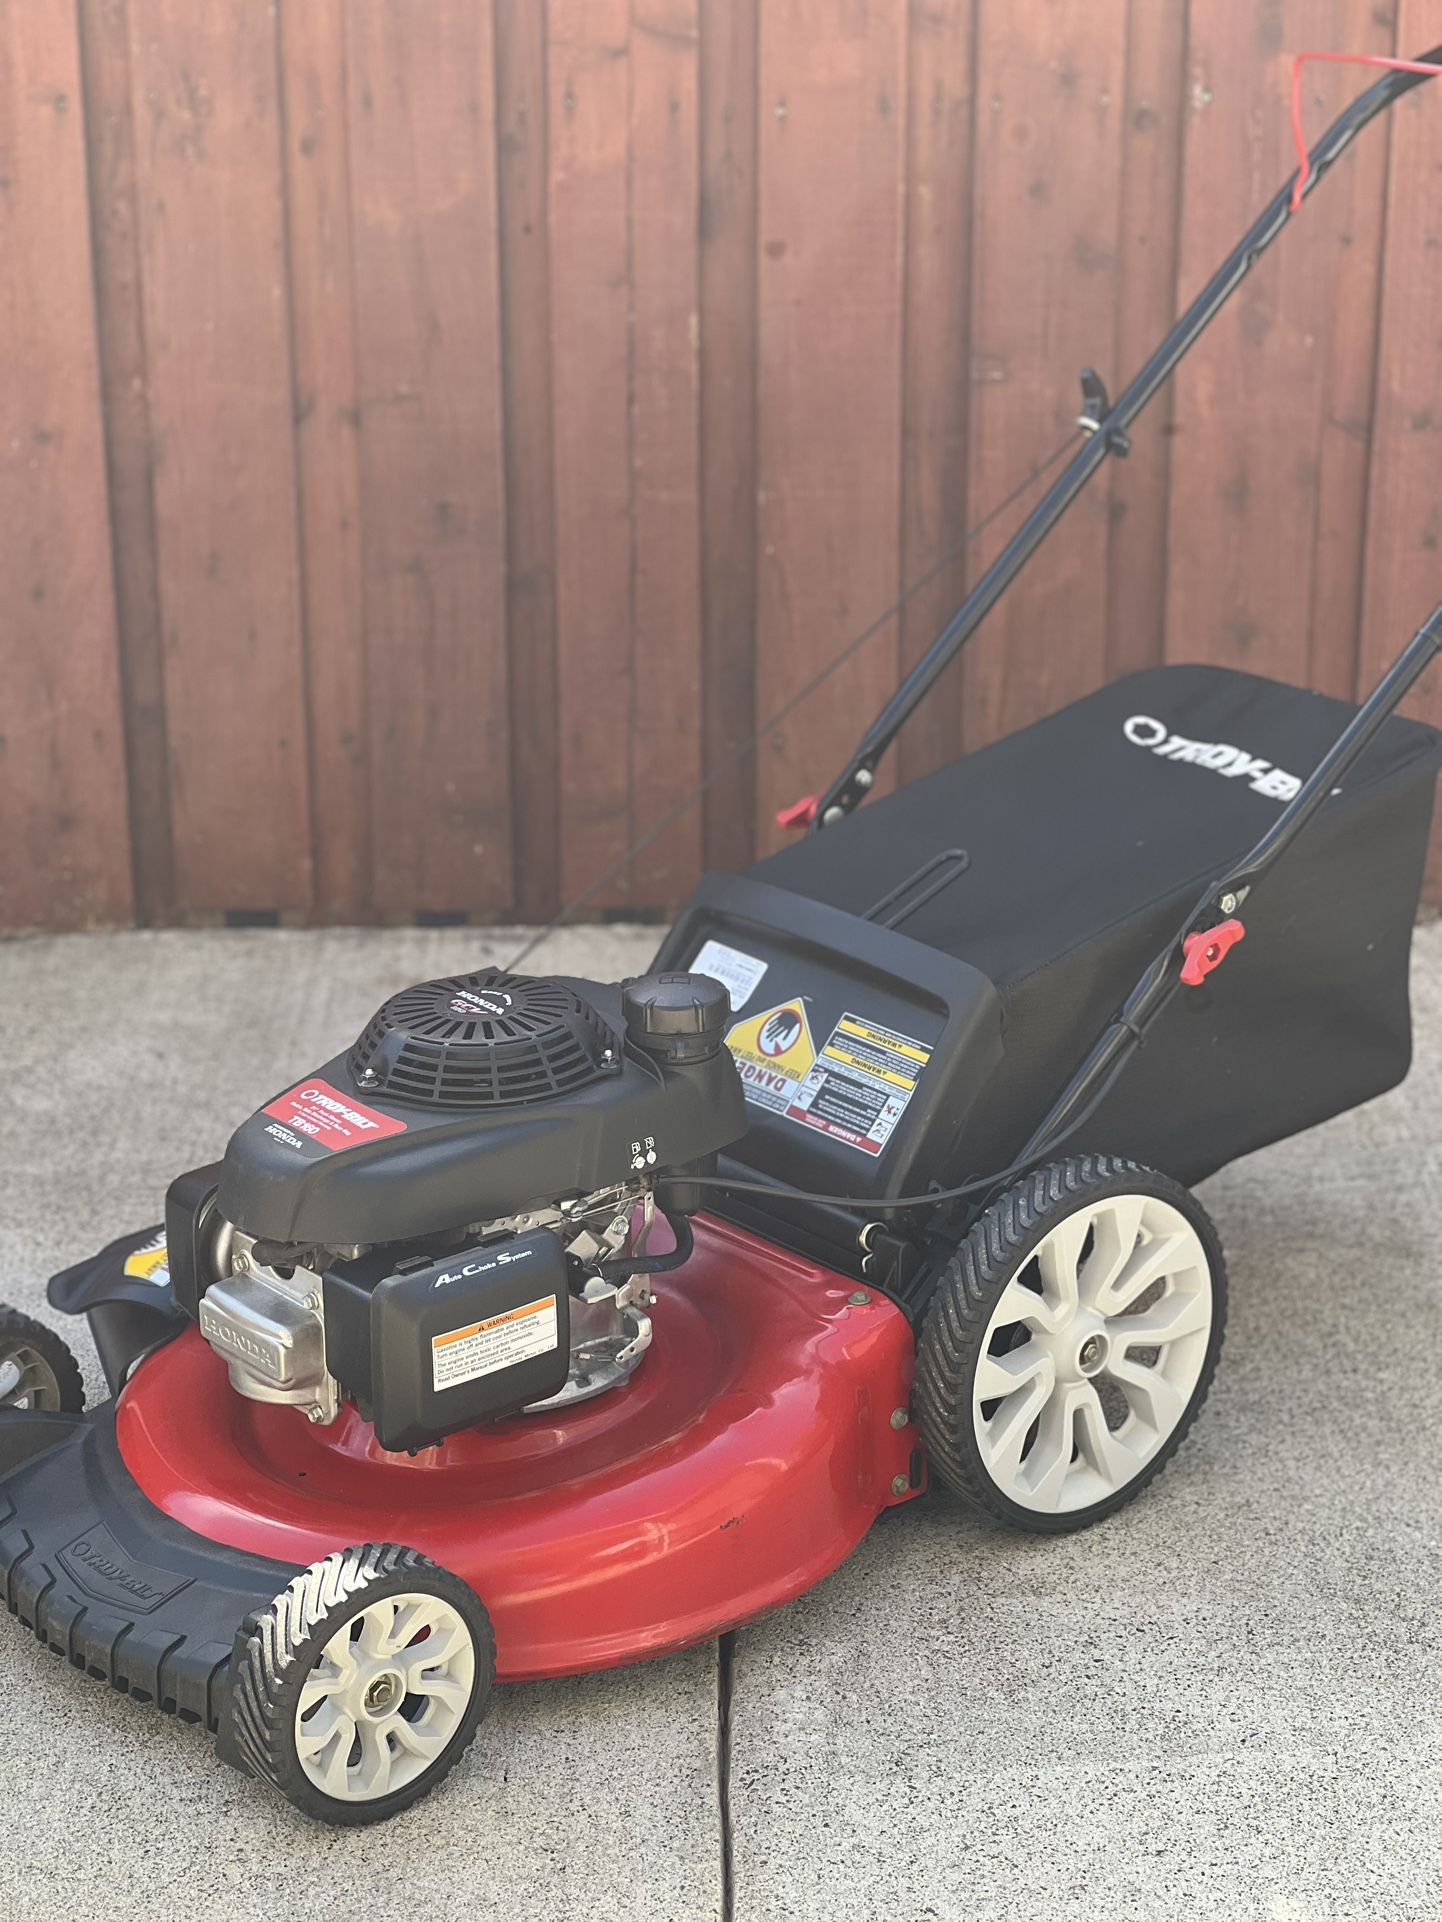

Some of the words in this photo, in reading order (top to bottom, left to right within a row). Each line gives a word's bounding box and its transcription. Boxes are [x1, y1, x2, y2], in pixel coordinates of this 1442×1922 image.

[1152, 735, 1303, 801] TROY-B
[456, 990, 504, 1015] HONDA
[867, 1031, 898, 1049] WARNING
[737, 1061, 787, 1092] DANGE
[851, 1058, 883, 1076] WARNING
[288, 1115, 320, 1134] TB160
[314, 1095, 379, 1129] TROY-BILT
[264, 1125, 303, 1148] HONDA
[828, 1123, 856, 1141] DANGER
[435, 1273, 462, 1288] Auto
[462, 1264, 496, 1276] Choke
[497, 1252, 532, 1265] System
[487, 1313, 513, 1328] WARNING
[204, 1314, 277, 1370] HONDA
[81, 1552, 164, 1600] TROY-BILT
